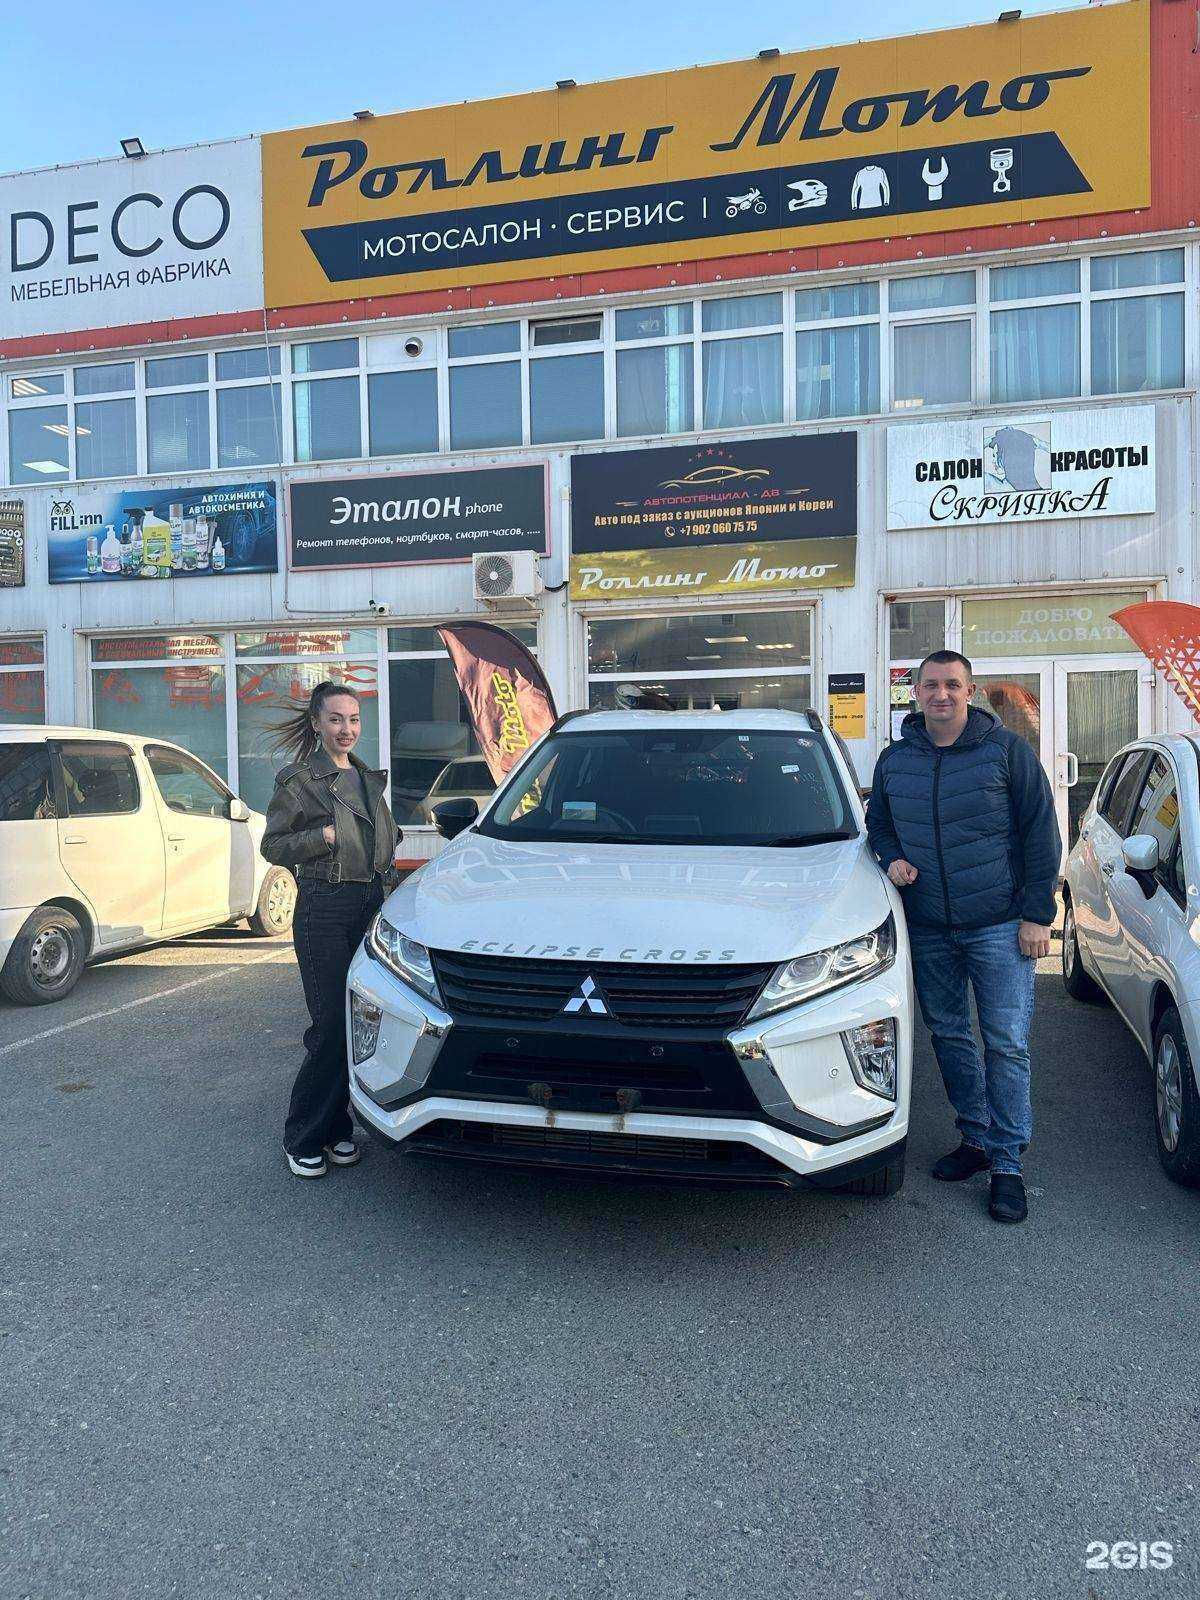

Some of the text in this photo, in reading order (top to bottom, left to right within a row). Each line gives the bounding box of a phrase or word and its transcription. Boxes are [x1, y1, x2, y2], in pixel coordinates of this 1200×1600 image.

[301, 66, 1092, 207] Роллинг Мото
[11, 184, 231, 272] DECO
[364, 200, 685, 260] МОТОСАЛОН СЕРВИС
[11, 257, 231, 302] МЕБЕЛЬНАЯ ФАБРИКА
[916, 446, 1148, 482] САЛОН КРАСОТЫ
[189, 501, 265, 514] АВТОКОСМЕТИКА
[202, 491, 265, 503] АВТОХИМИЯ И
[643, 491, 750, 506] АВТОПОТЕНЦИАЛ
[761, 488, 780, 498] ДВ
[329, 496, 503, 525] Эталон phone
[594, 500, 834, 526] Авто под заказ с аукционов Японии и Кореи
[296, 538, 334, 549] Ремонт
[335, 536, 394, 548] телефонов,
[396, 532, 452, 545] ноутбуков,
[455, 527, 524, 541] смарт-часов,
[680, 521, 757, 536] +7 902 060 75 75
[578, 558, 839, 591] Роллинг Мото
[1018, 607, 1093, 624] ДОБРО
[460, 940, 736, 961] ECLIPSE CROSS
